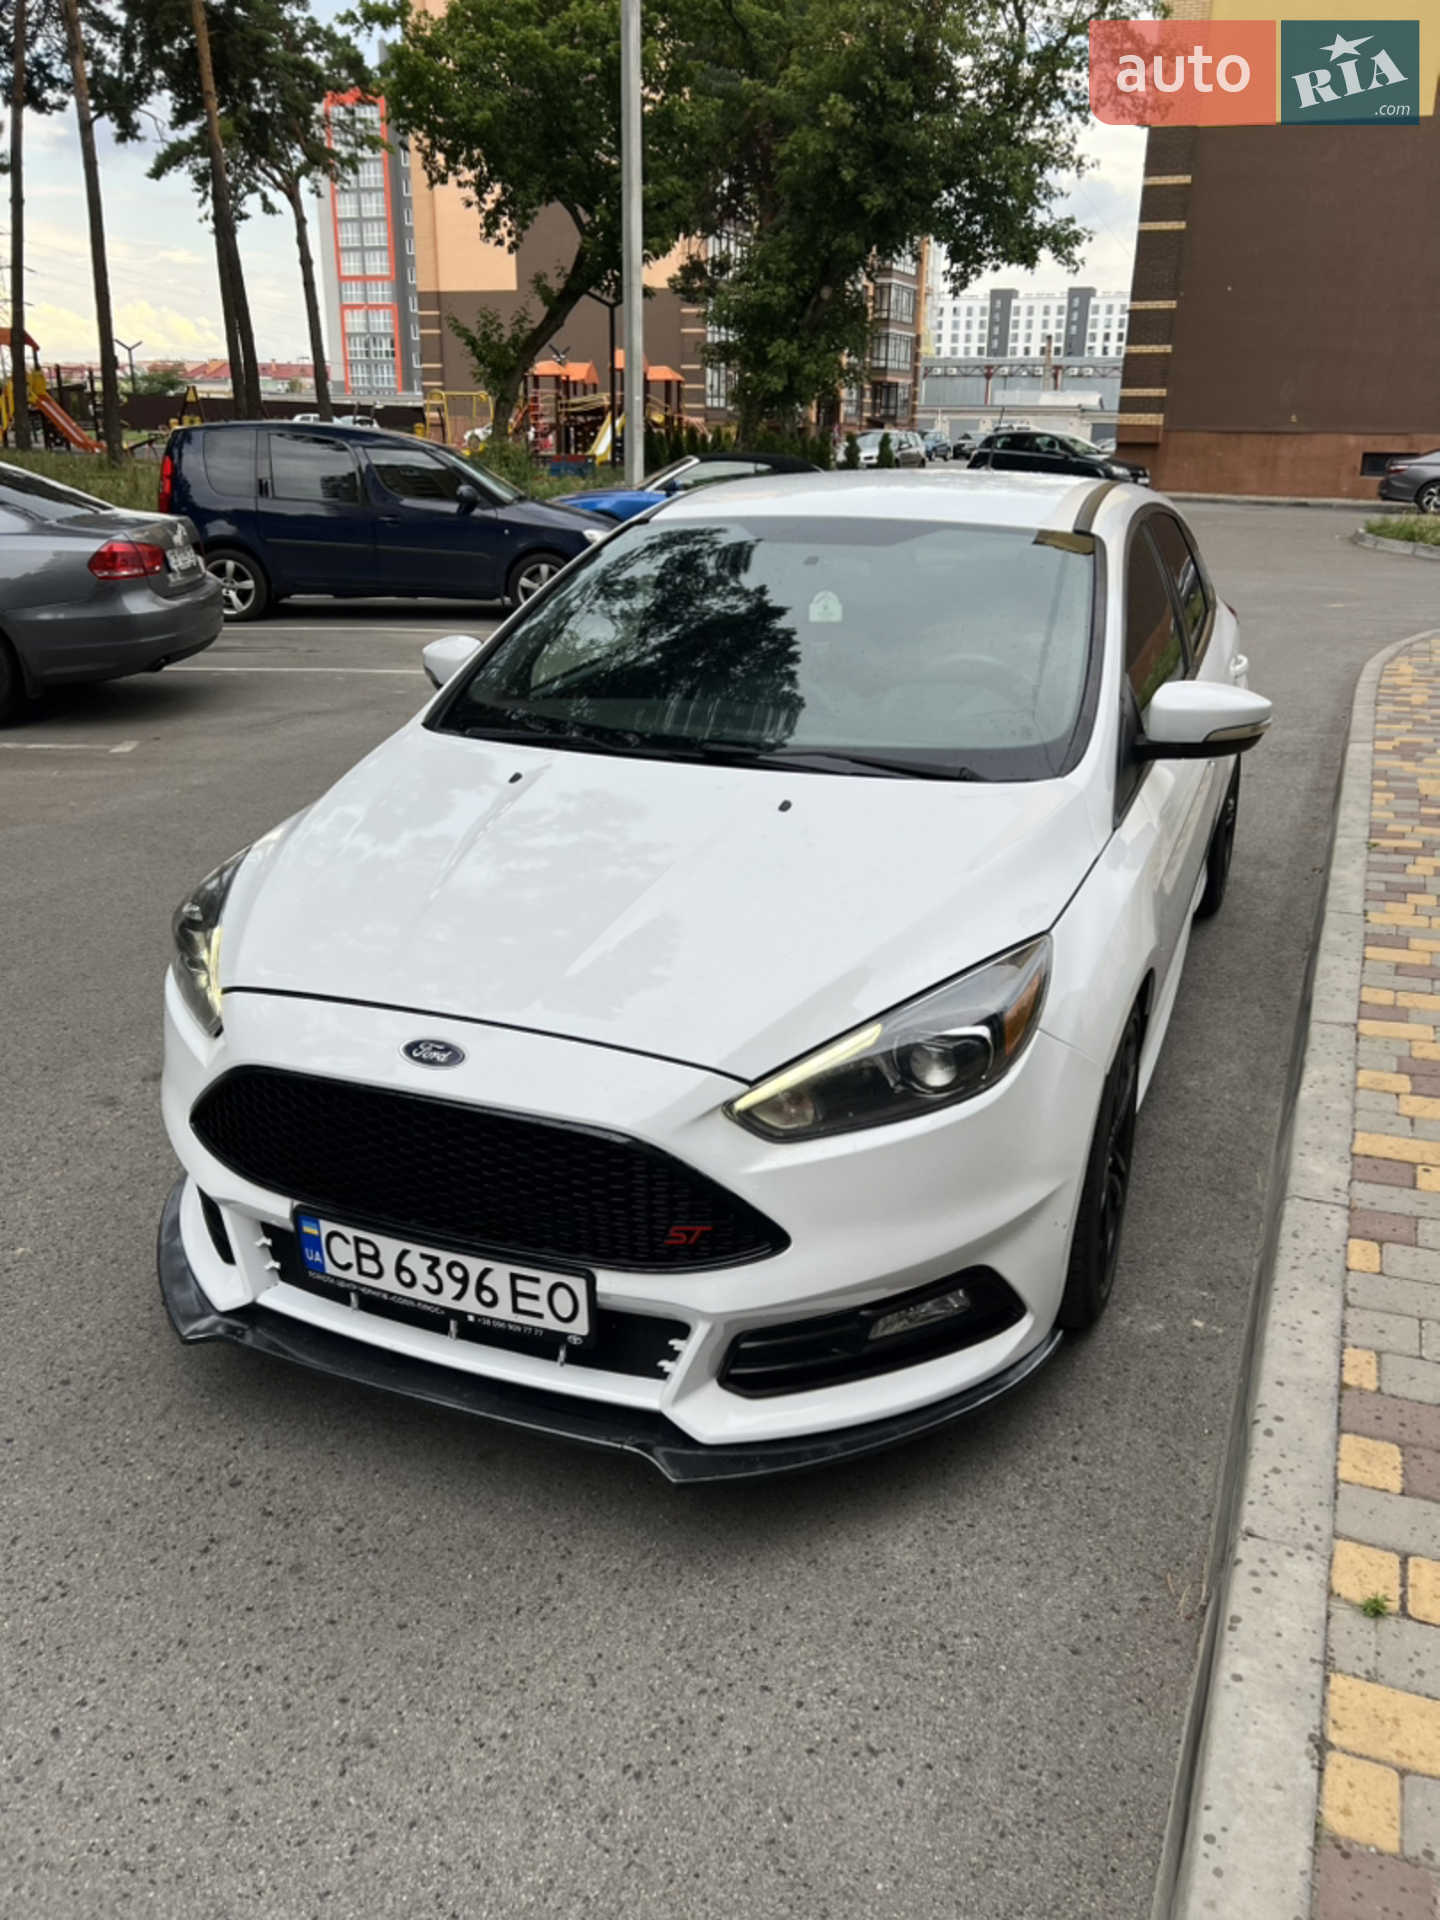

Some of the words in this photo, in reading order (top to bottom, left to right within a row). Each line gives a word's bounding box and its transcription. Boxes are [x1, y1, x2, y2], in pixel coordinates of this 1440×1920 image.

[412, 1041, 452, 1063] Ford
[663, 1226, 714, 1245] ST
[305, 1247, 322, 1263] UA
[325, 1230, 384, 1280] CB
[394, 1248, 499, 1308] 6396
[509, 1271, 579, 1323] EO
